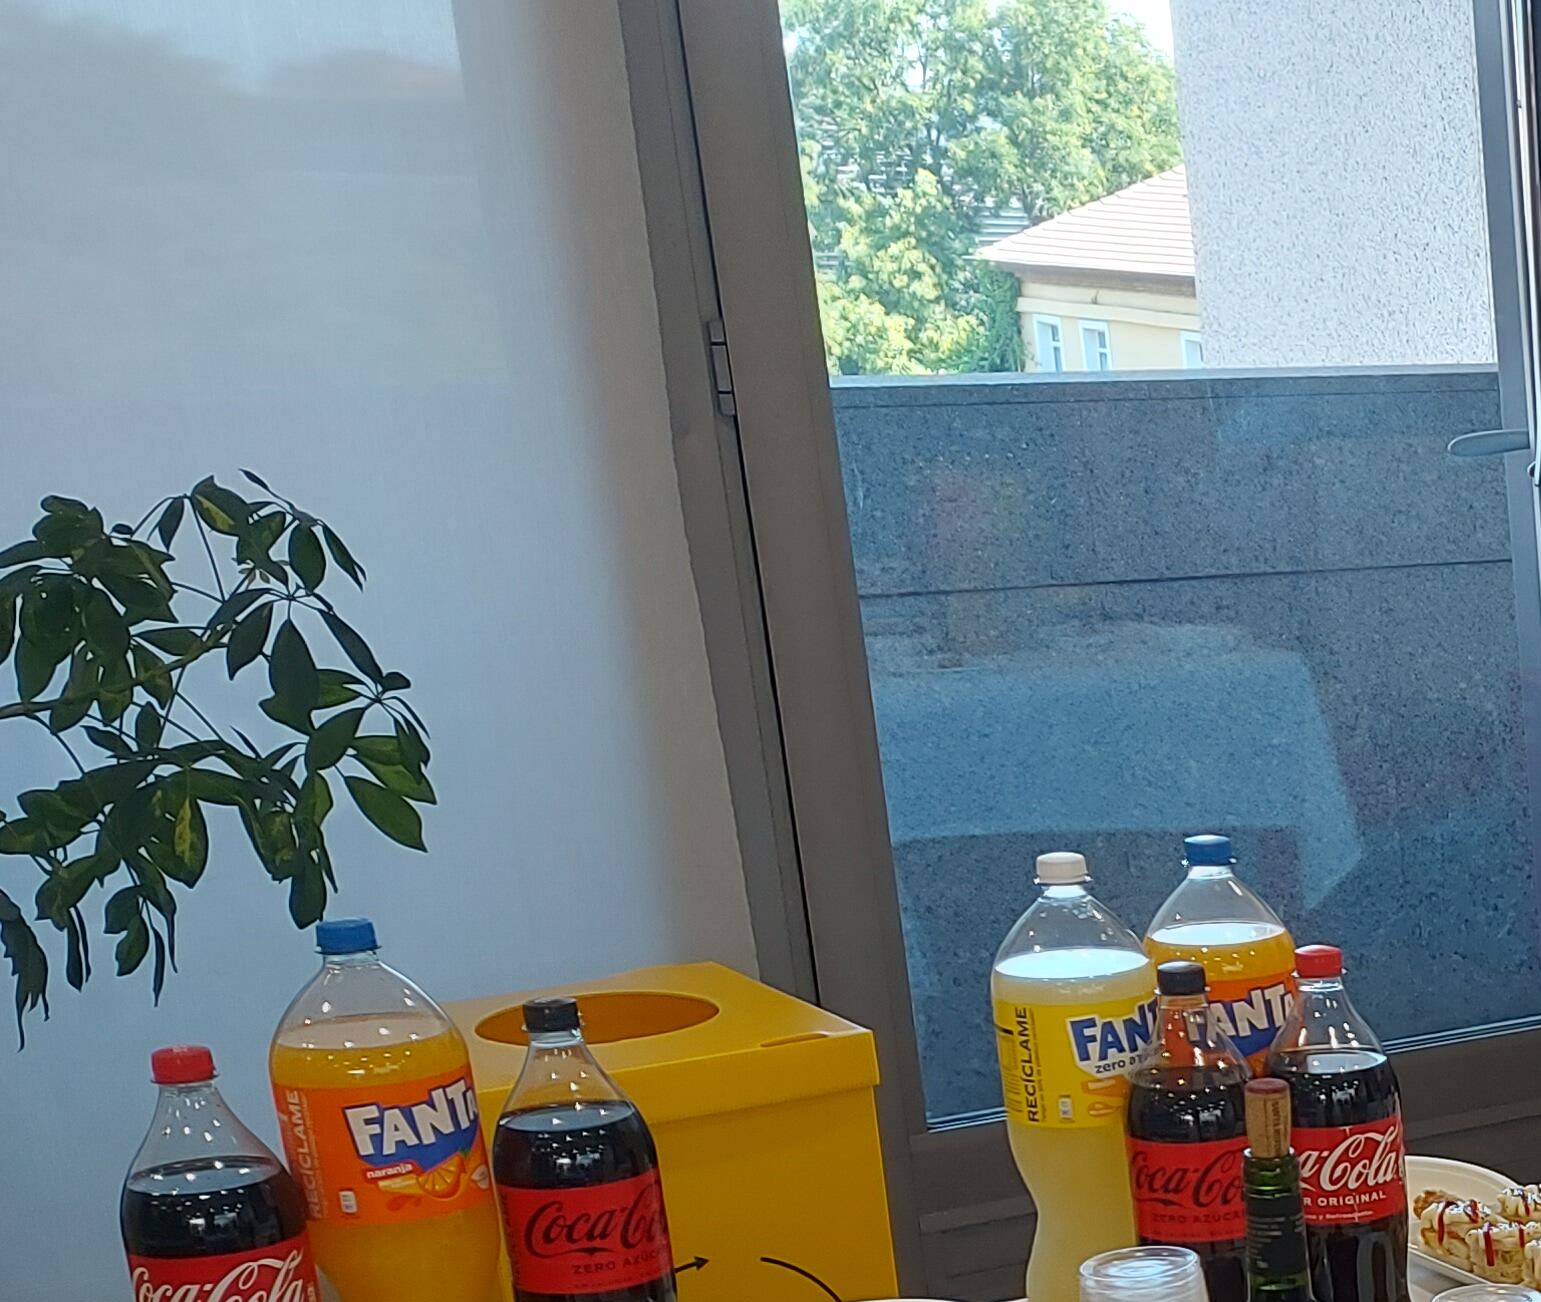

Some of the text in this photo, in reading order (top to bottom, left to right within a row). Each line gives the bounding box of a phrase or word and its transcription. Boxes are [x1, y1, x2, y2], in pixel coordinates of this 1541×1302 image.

[1014, 1007, 1040, 1123] RECÍCLAME
[1095, 1058, 1126, 1074] zero
[344, 1078, 479, 1156] FANTA
[366, 1163, 413, 1179] naranja
[1298, 1122, 1398, 1192] a-Cola
[1132, 1150, 1245, 1209] Coca-Co
[1317, 1190, 1387, 1207] ORIGINAL
[572, 1260, 616, 1274] ZERO
